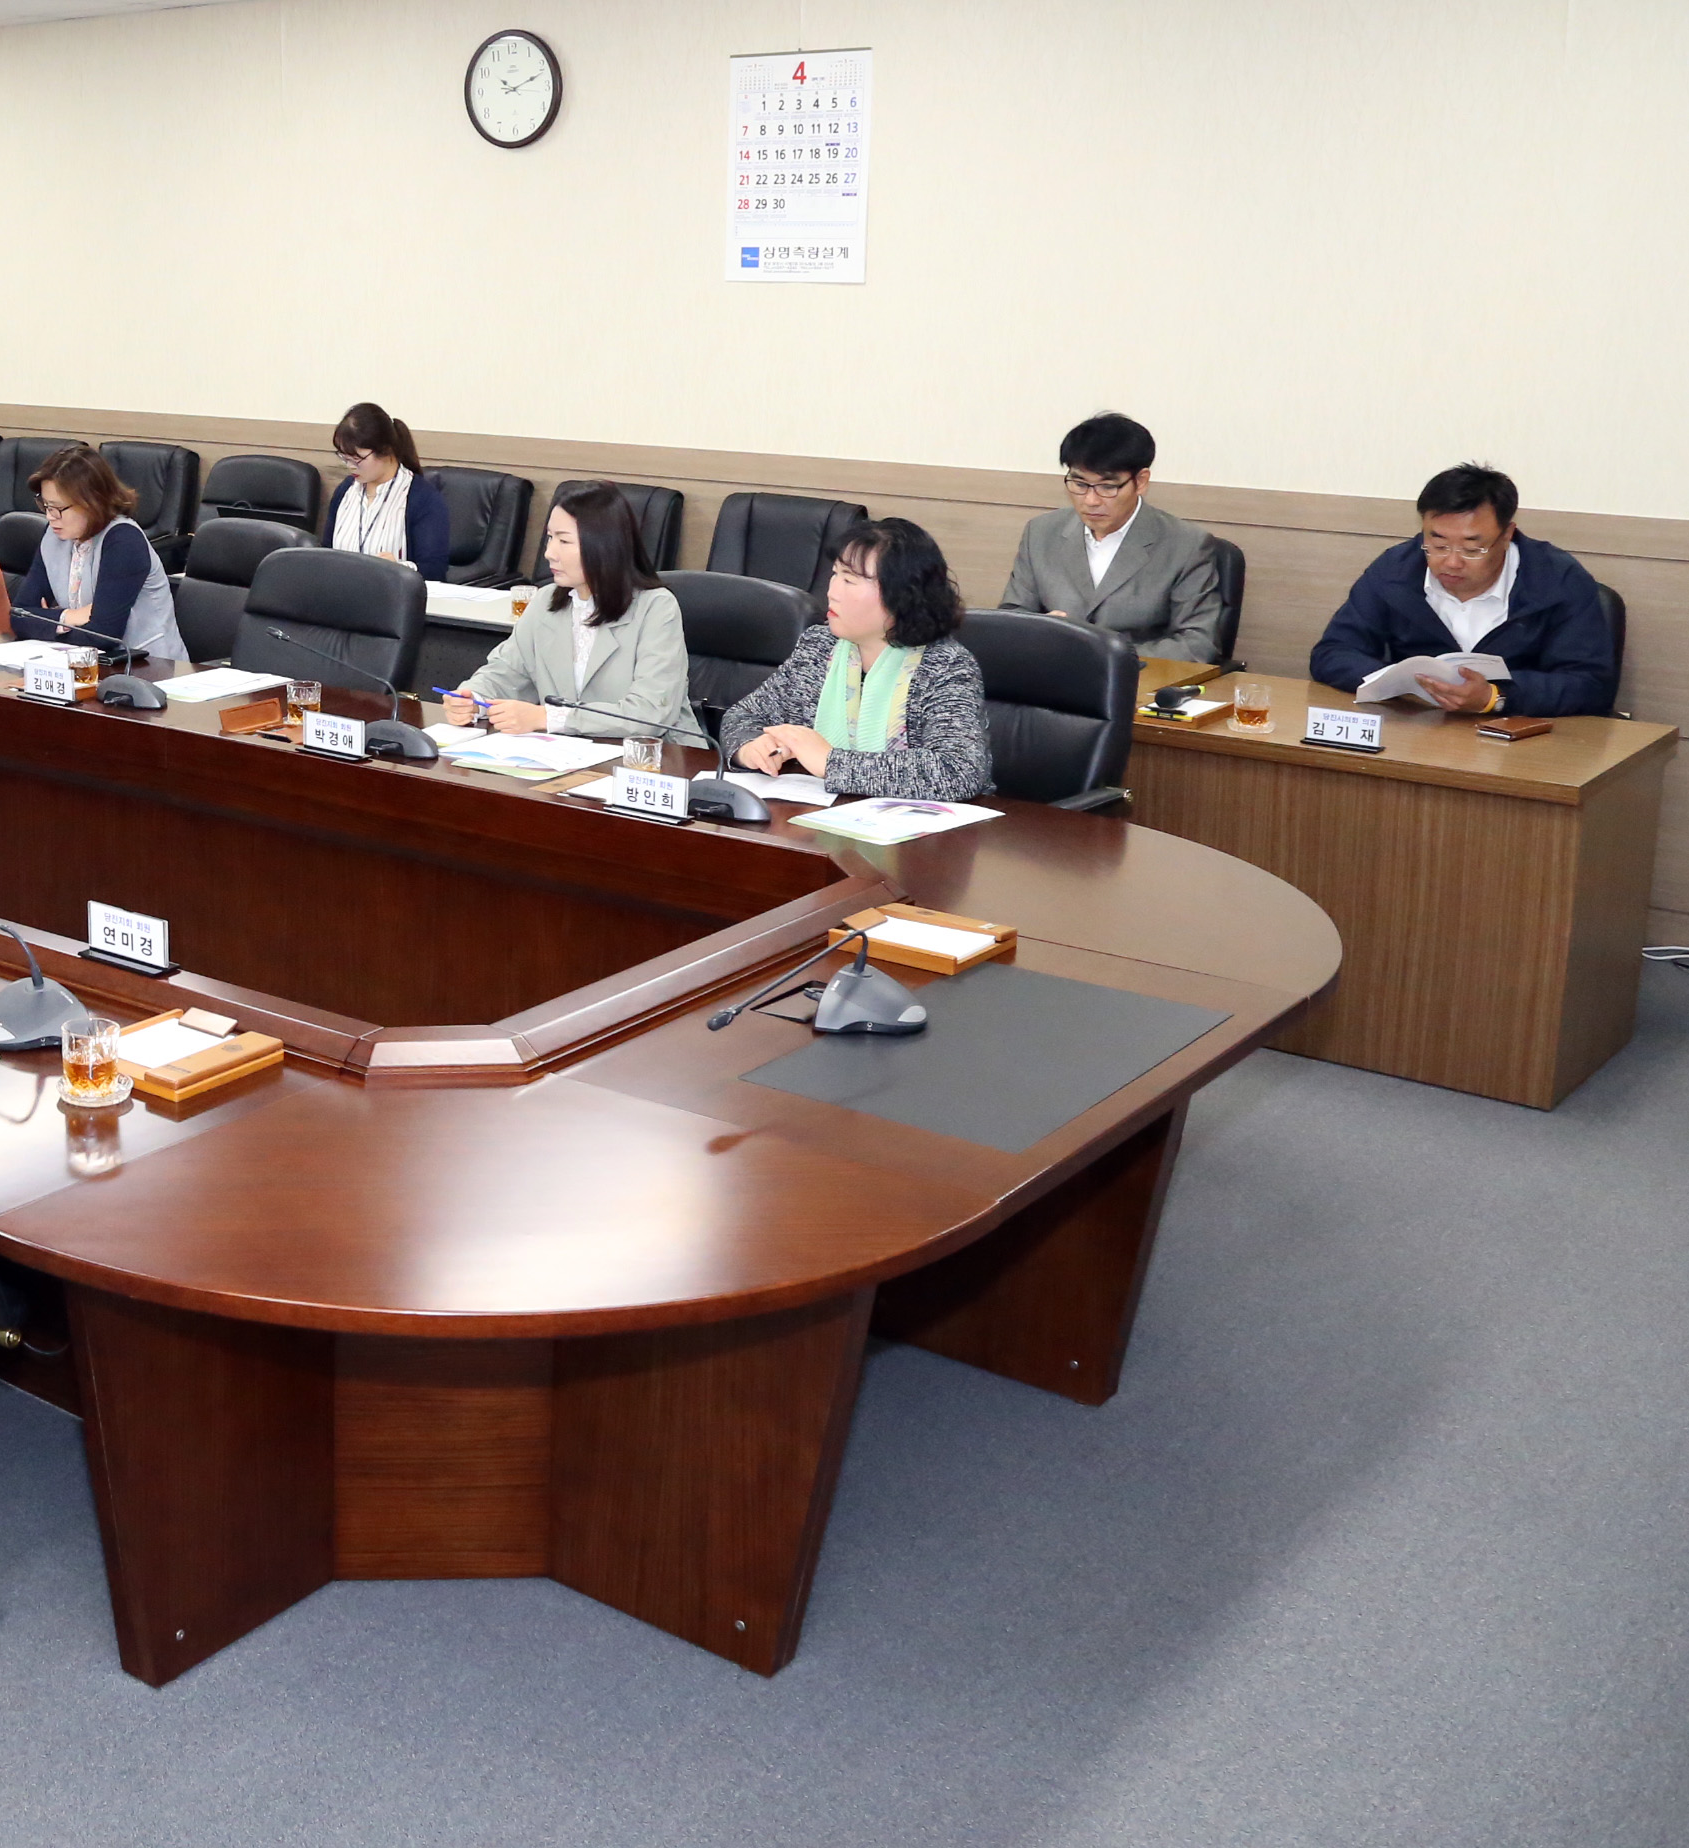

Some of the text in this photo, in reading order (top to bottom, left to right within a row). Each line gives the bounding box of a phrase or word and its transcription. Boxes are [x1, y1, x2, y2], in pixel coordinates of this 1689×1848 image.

[792, 62, 807, 85] 4
[761, 97, 857, 111] 1 2 3 4 5 6
[742, 122, 858, 136] 7 8 9 10 11 12 13
[740, 147, 857, 160] 14 15 16 17 18 19 20
[740, 173, 856, 185] 21 22 23 24 25 26 27
[738, 199, 785, 209] 28 29 30
[34, 678, 65, 694] 김애경
[1323, 713, 1359, 724] 당진시의회
[315, 729, 353, 749] 박경애
[1312, 722, 1375, 743] 김기재
[628, 774, 674, 790] 당진지회 회원
[626, 786, 674, 810] 방인희
[104, 912, 151, 933] 당진지회 회원
[104, 926, 153, 956] 연미경
